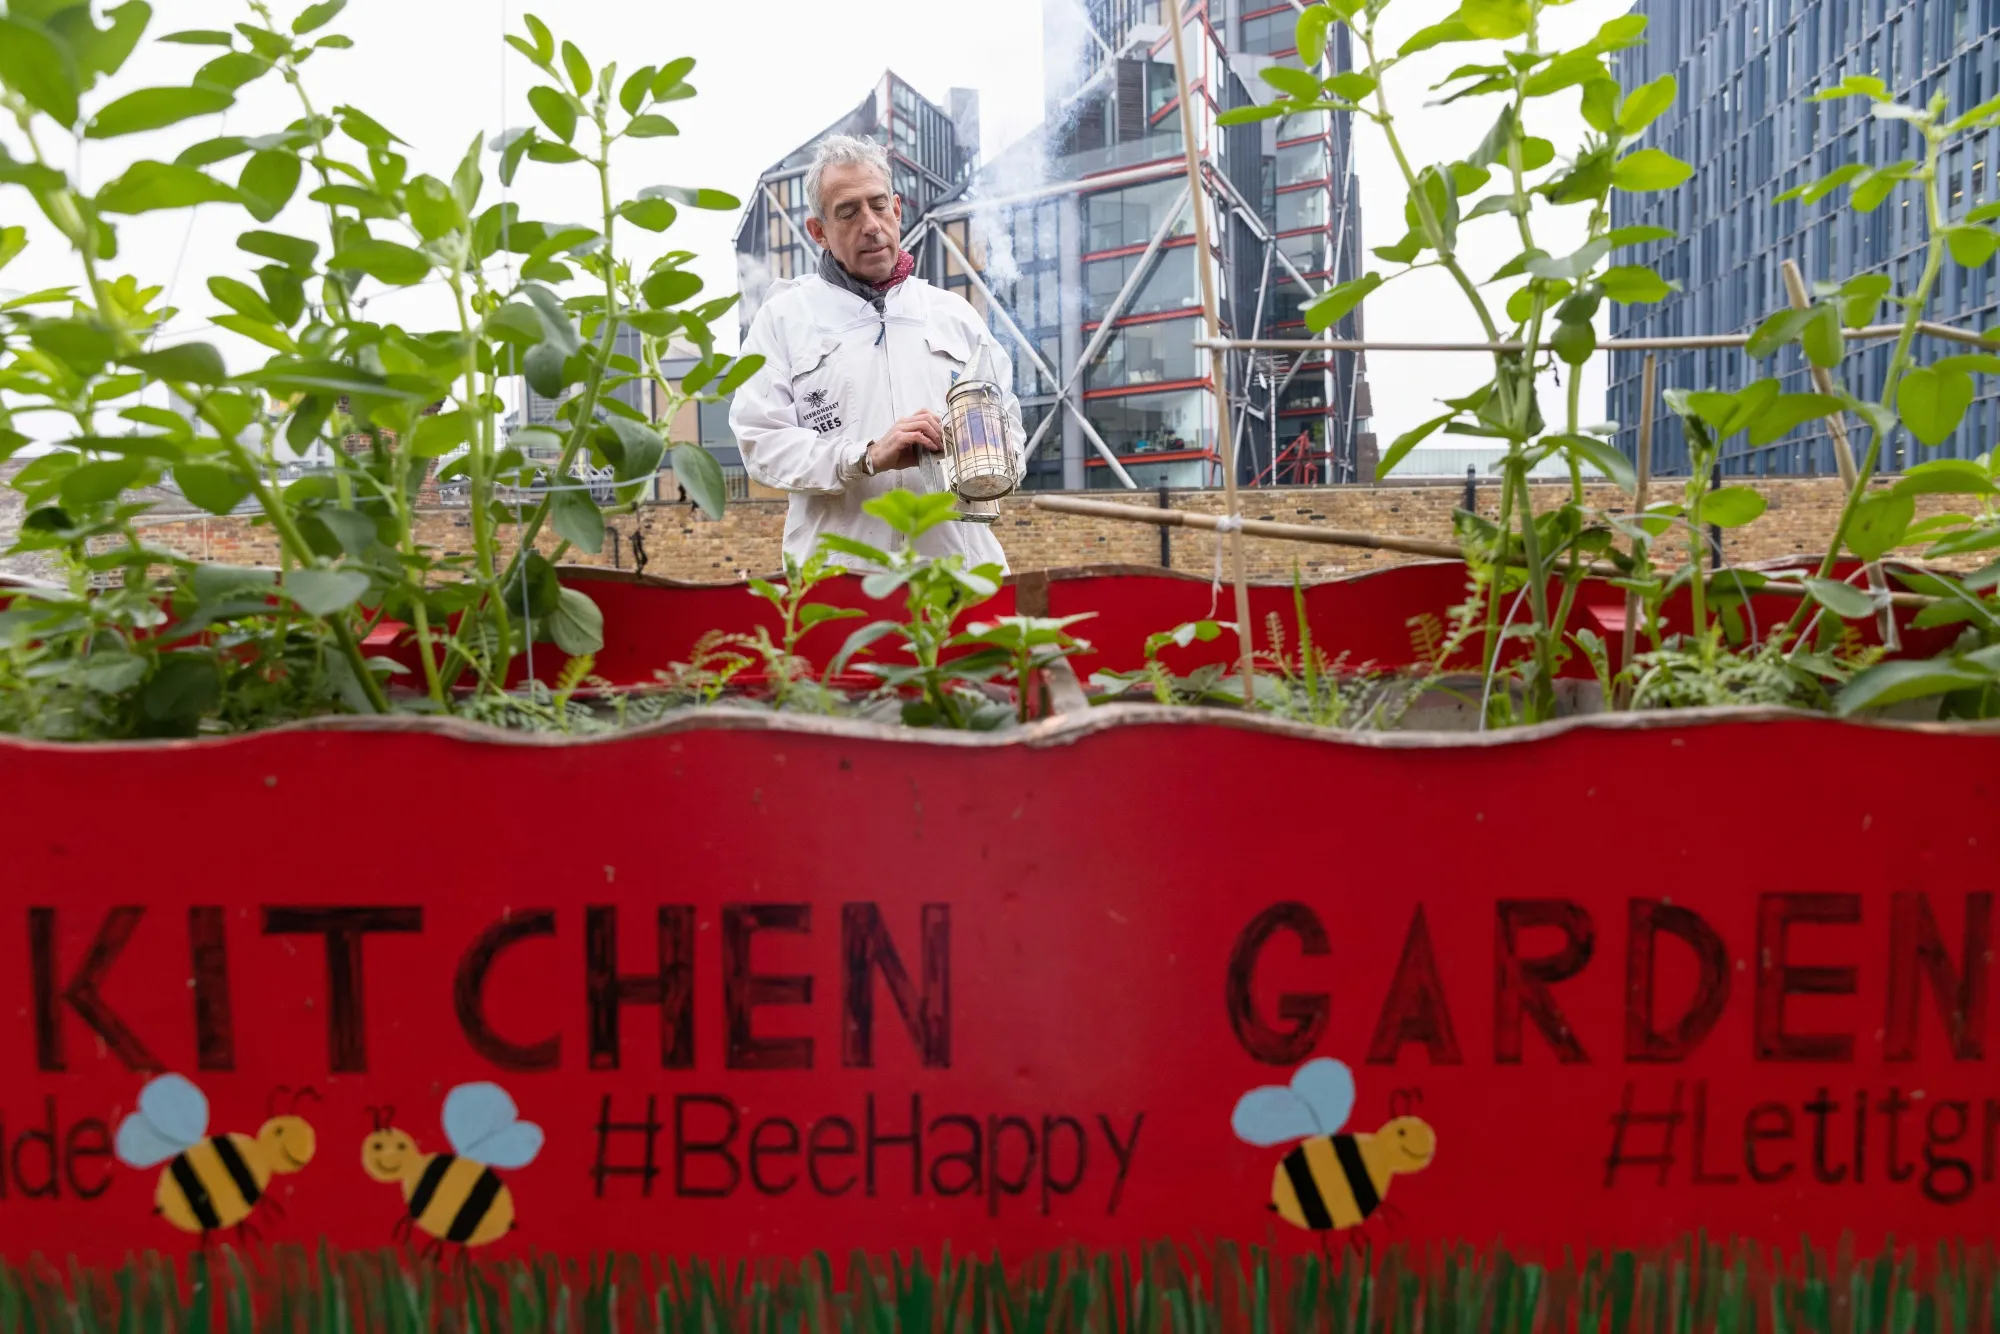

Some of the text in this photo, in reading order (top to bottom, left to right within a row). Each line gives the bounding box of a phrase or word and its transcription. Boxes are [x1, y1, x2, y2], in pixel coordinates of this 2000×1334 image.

[803, 402, 839, 420] BERMONDSEY
[813, 412, 834, 423] STREET
[27, 892, 1993, 1074] KITCHEN GARDEN
[589, 1093, 1146, 1217] #BeeHappy
